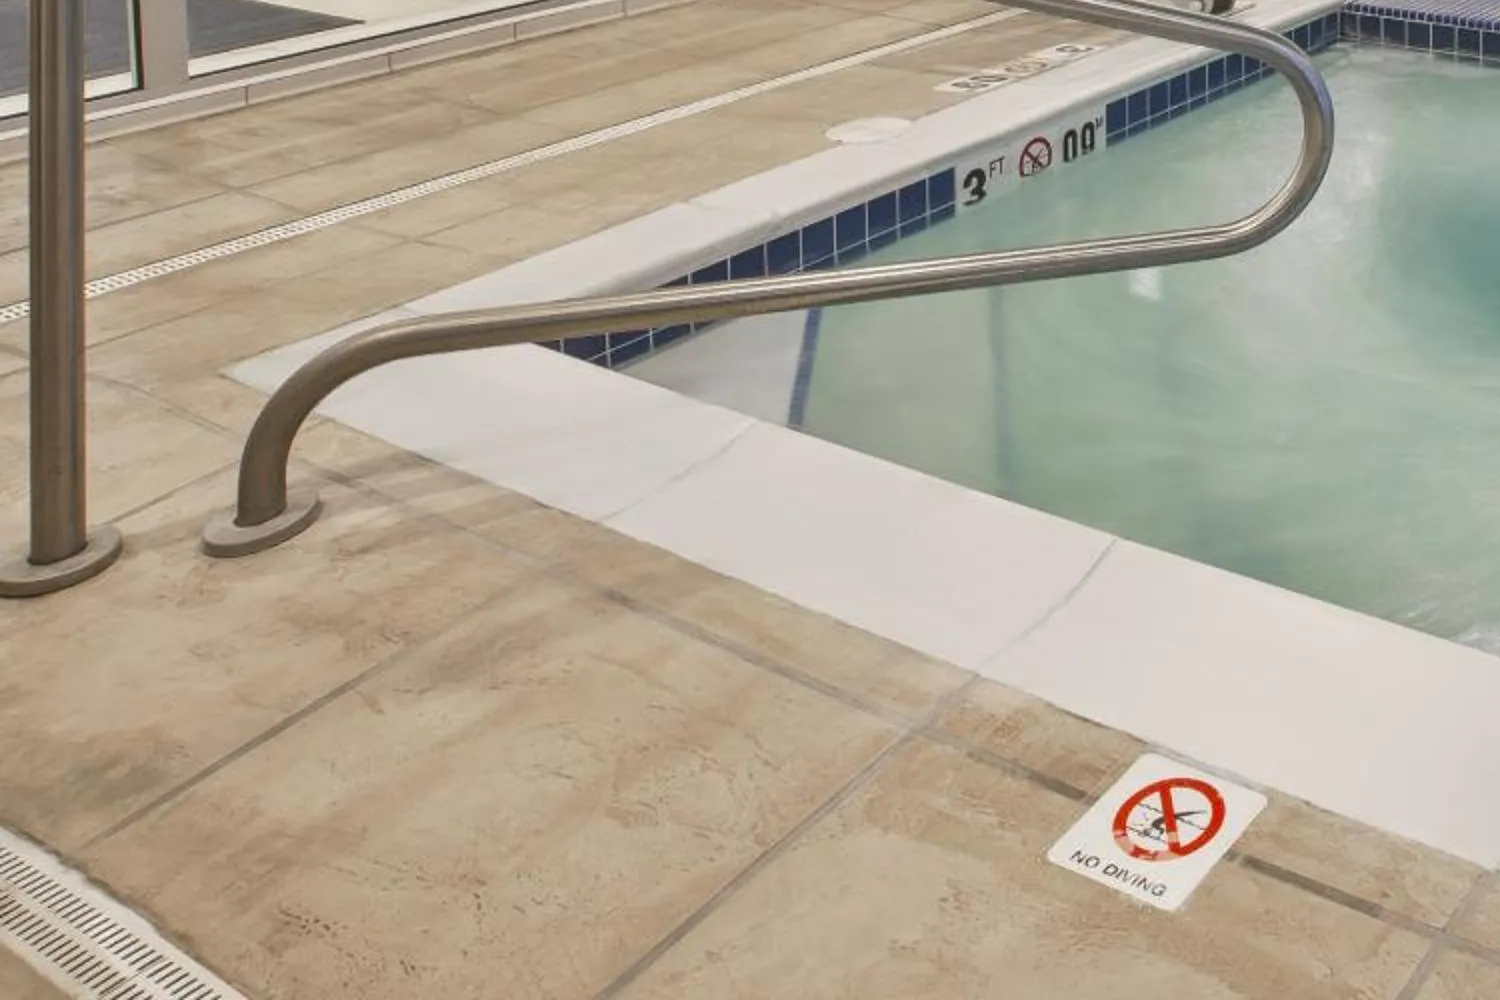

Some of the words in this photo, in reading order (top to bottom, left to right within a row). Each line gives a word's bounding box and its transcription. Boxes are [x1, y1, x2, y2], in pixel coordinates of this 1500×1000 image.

[962, 169, 987, 206] 3
[989, 155, 1005, 178] FT
[1070, 849, 1100, 869] NO
[1102, 863, 1168, 897] DIVING
